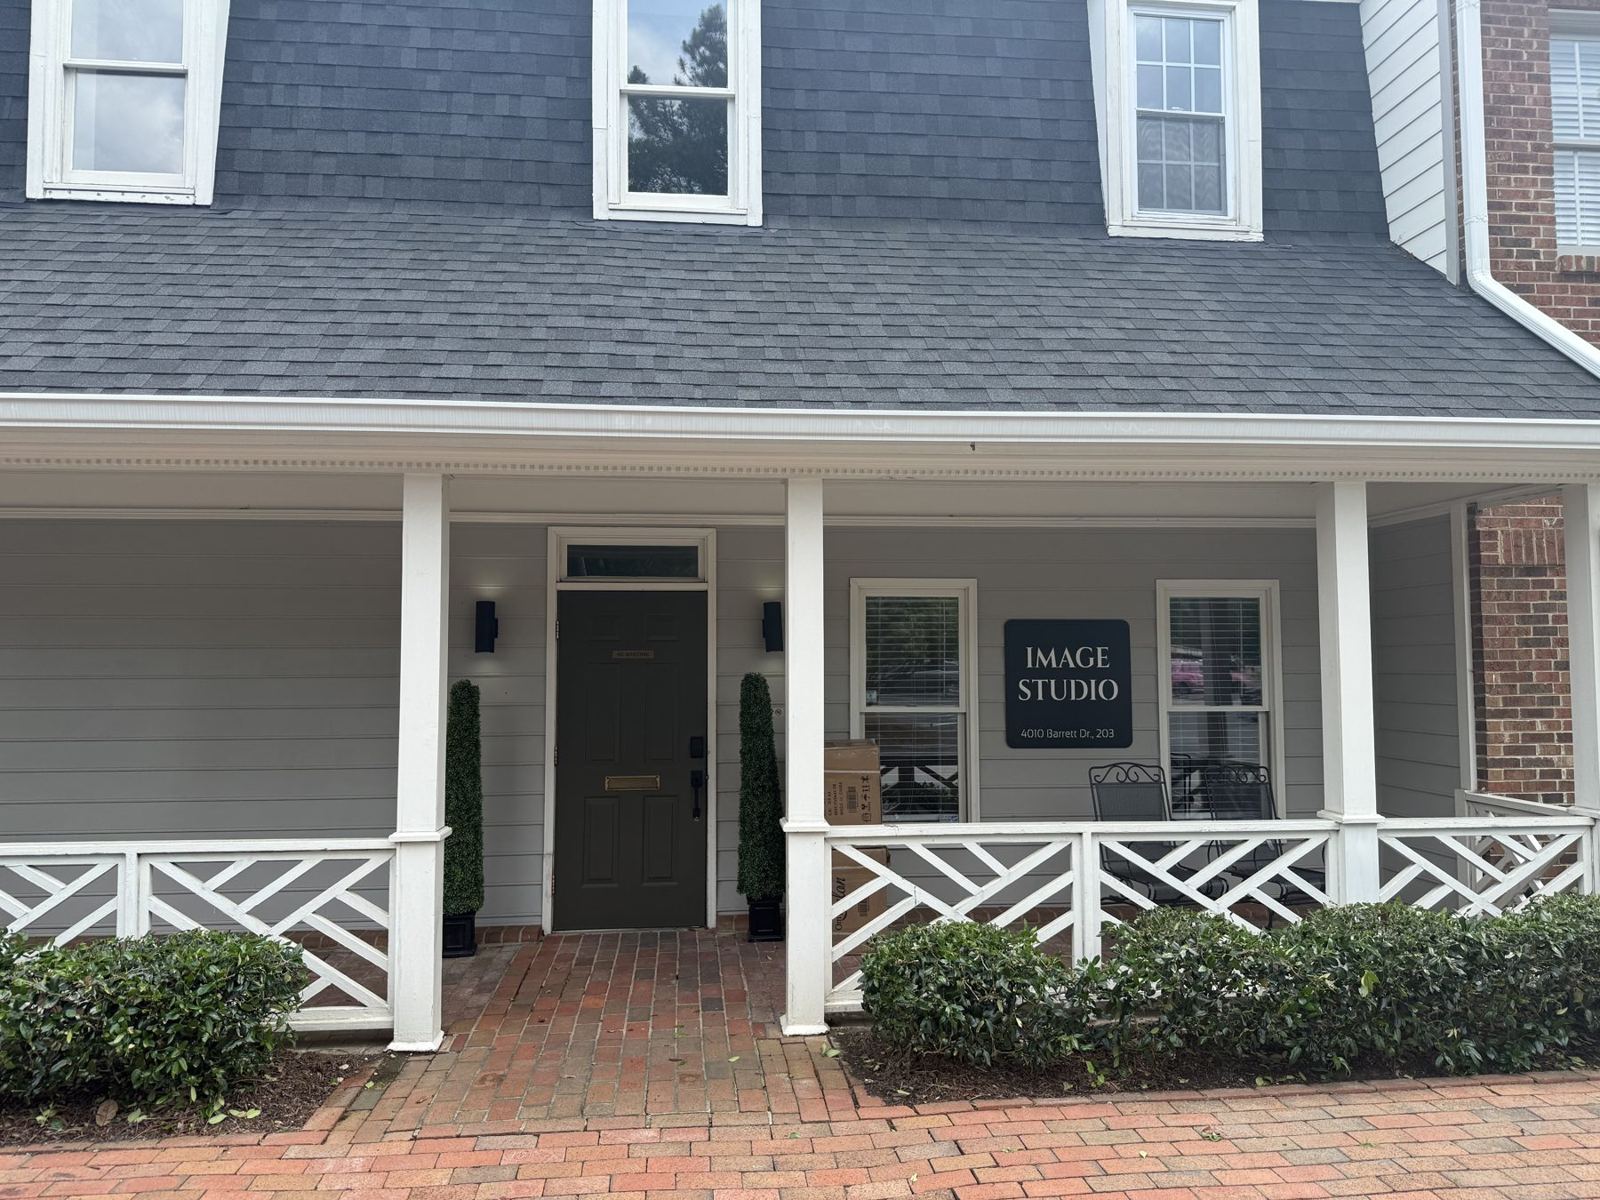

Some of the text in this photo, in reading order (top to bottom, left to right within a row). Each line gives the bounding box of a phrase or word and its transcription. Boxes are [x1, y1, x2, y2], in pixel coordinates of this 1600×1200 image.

[1025, 646, 1110, 669] IMAGE
[1018, 678, 1119, 701] STUDIO
[1021, 728, 1045, 739] 4010
[1046, 728, 1077, 739] Barrett
[1096, 728, 1115, 739] 203
